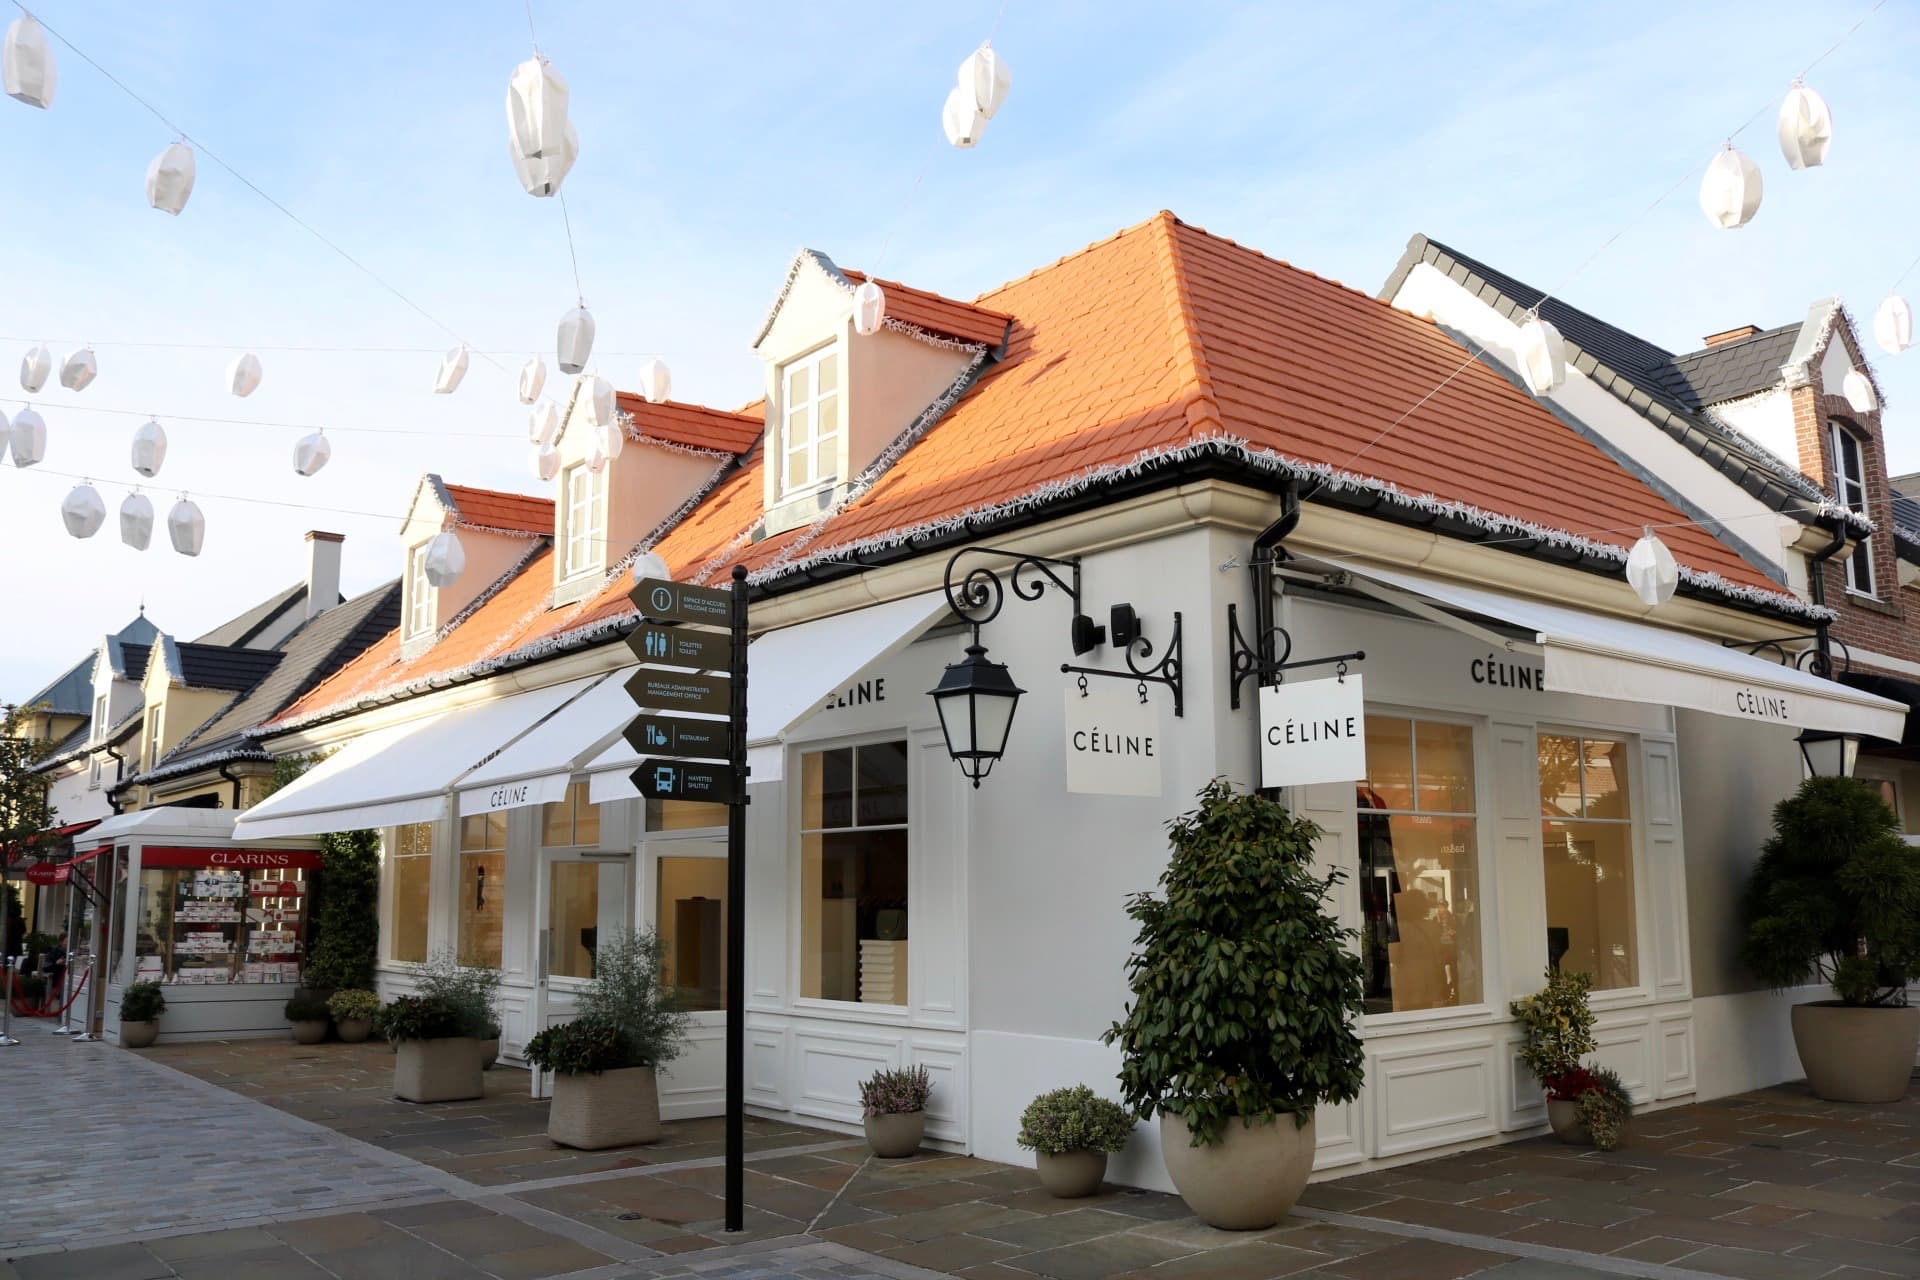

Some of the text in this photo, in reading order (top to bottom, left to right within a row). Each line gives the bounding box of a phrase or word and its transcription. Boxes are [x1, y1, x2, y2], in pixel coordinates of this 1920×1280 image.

[684, 604, 708, 612] WELCOME
[679, 641, 702, 649] TOILETTES
[1471, 653, 1544, 692] CÉLINE
[647, 682, 670, 690] BUREAUX
[647, 689, 702, 700] MANAGEMENT OFFICE
[1736, 688, 1789, 720] CÉLINE
[1267, 717, 1356, 746] CÉLINE
[679, 734, 710, 742] RESTAURANT
[1073, 726, 1154, 757] CÉLINE
[687, 775, 713, 783] NAVETTES
[687, 782, 710, 790] SHUTTLE
[490, 785, 528, 808] CÉLINE
[210, 852, 289, 865] CLARINS
